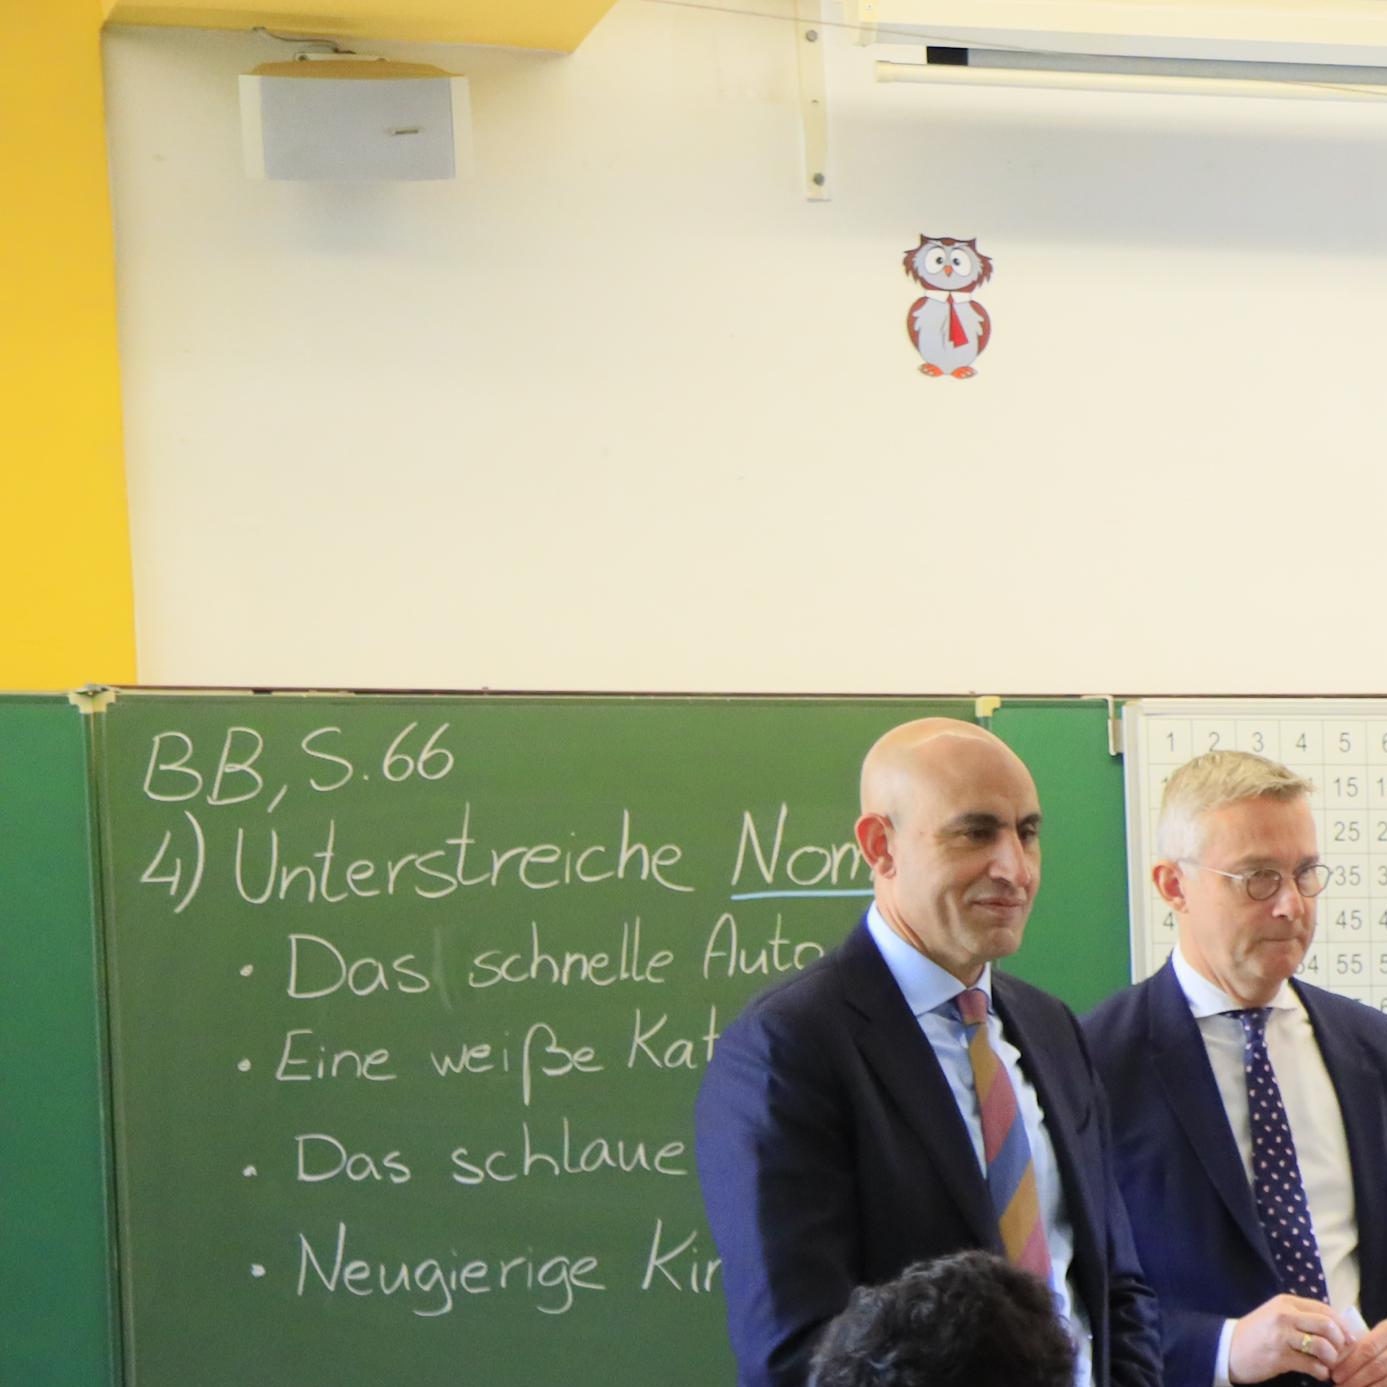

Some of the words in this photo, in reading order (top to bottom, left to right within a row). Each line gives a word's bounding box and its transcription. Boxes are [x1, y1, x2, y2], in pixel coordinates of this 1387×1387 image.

[1166, 731, 1174, 752] 1
[1208, 731, 1222, 753] 2
[1252, 731, 1266, 753] 3
[1295, 732, 1308, 752] 4
[1339, 731, 1352, 753] 5
[1333, 776, 1359, 798] 15
[1333, 820, 1361, 842] 25
[140, 811, 205, 913] 4)
[235, 803, 695, 905] Unterstreiche
[1335, 865, 1361, 887] 35
[1335, 909, 1363, 931] 45
[287, 933, 431, 1000] Das
[467, 918, 675, 988] schnelle
[703, 912, 825, 980] Auto
[1336, 953, 1363, 975] 55
[275, 1029, 398, 1082] Eine
[432, 1022, 604, 1106] weiße
[627, 1005, 717, 1070] Kat
[295, 1134, 412, 1184] Das
[451, 1118, 689, 1185] schlaue
[297, 1222, 607, 1317] Neugierige
